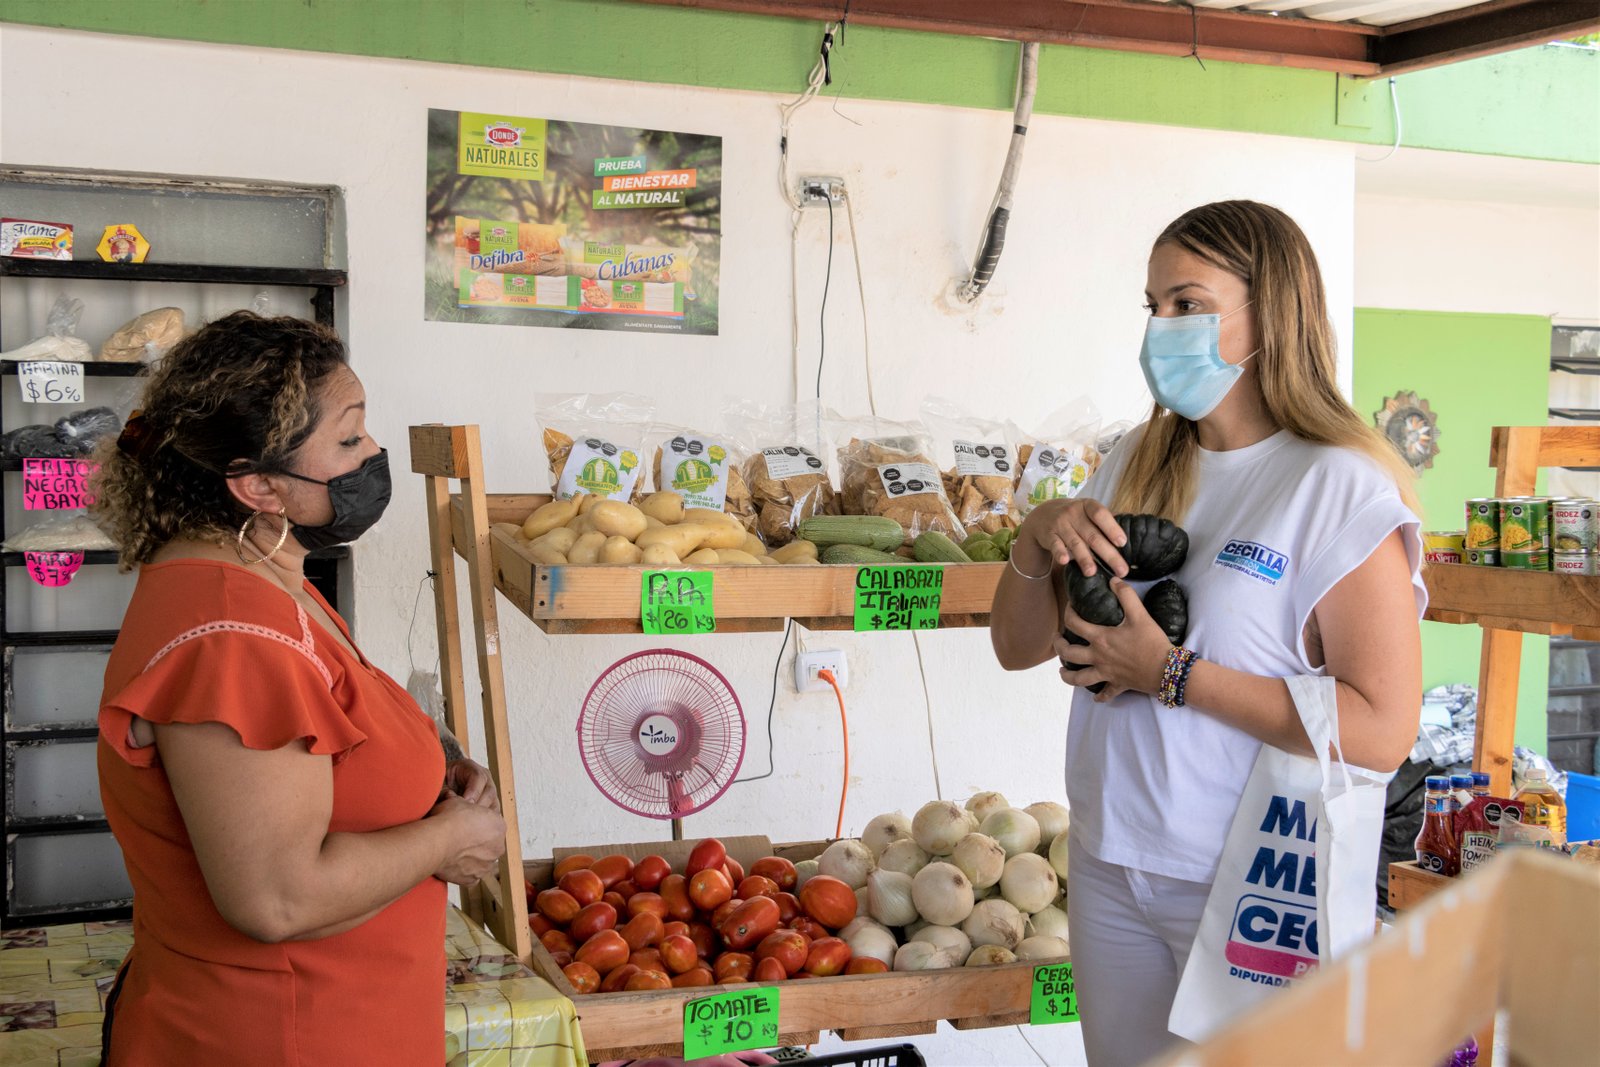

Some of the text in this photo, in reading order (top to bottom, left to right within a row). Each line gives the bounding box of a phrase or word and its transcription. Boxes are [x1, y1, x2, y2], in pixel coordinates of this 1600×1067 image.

[492, 130, 515, 141] DONDE
[466, 147, 539, 167] NATURALES
[598, 160, 642, 171] PRUEBA
[611, 173, 690, 189] BIENESTAR
[597, 196, 612, 205] AL
[588, 247, 622, 255] NATURALES
[471, 249, 524, 271] Defibra
[598, 252, 674, 280] Cubanas
[20, 360, 79, 376] HARINA
[27, 494, 36, 509] Y
[1224, 542, 1284, 573] CECILIA
[856, 567, 944, 589] CALABAZA
[650, 733, 676, 744] imba
[688, 995, 771, 1023] TOMATE
